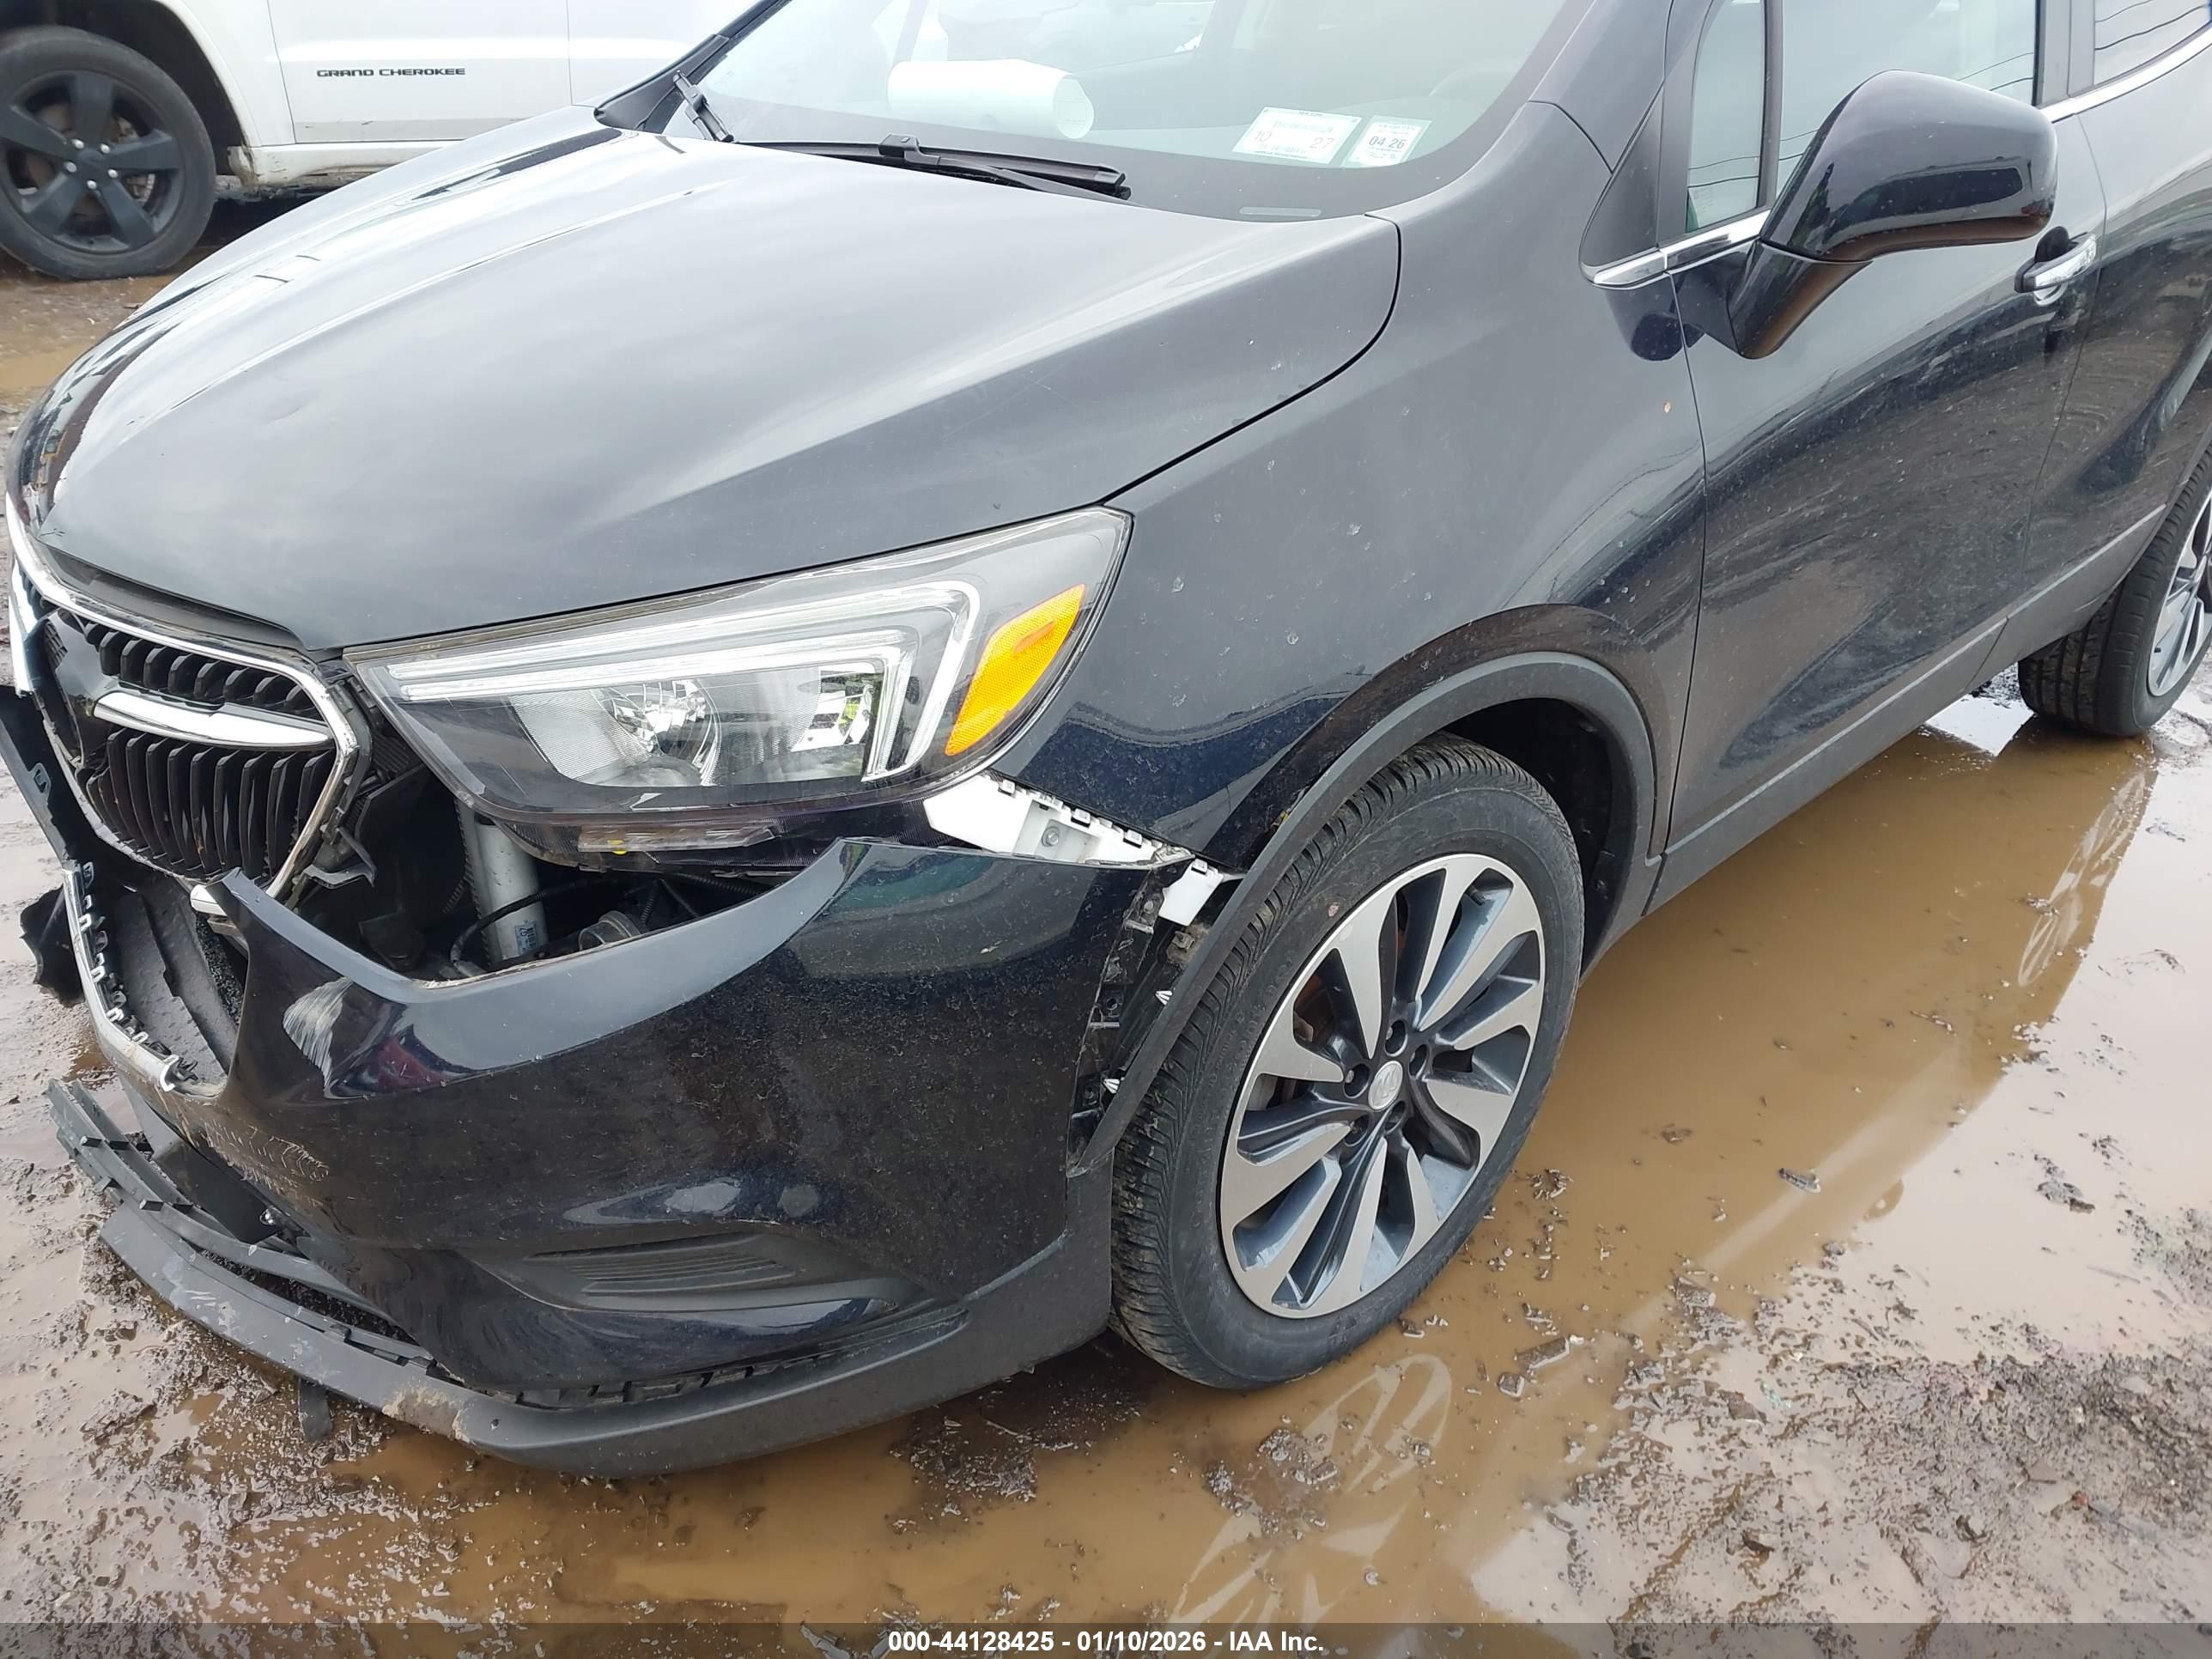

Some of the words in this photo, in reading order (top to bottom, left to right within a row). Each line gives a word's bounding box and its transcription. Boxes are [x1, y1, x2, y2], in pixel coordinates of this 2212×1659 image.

[1255, 130, 1273, 143] 10
[1309, 137, 1336, 149] 27
[1369, 135, 1387, 147] 04
[1388, 137, 1407, 149] 26
